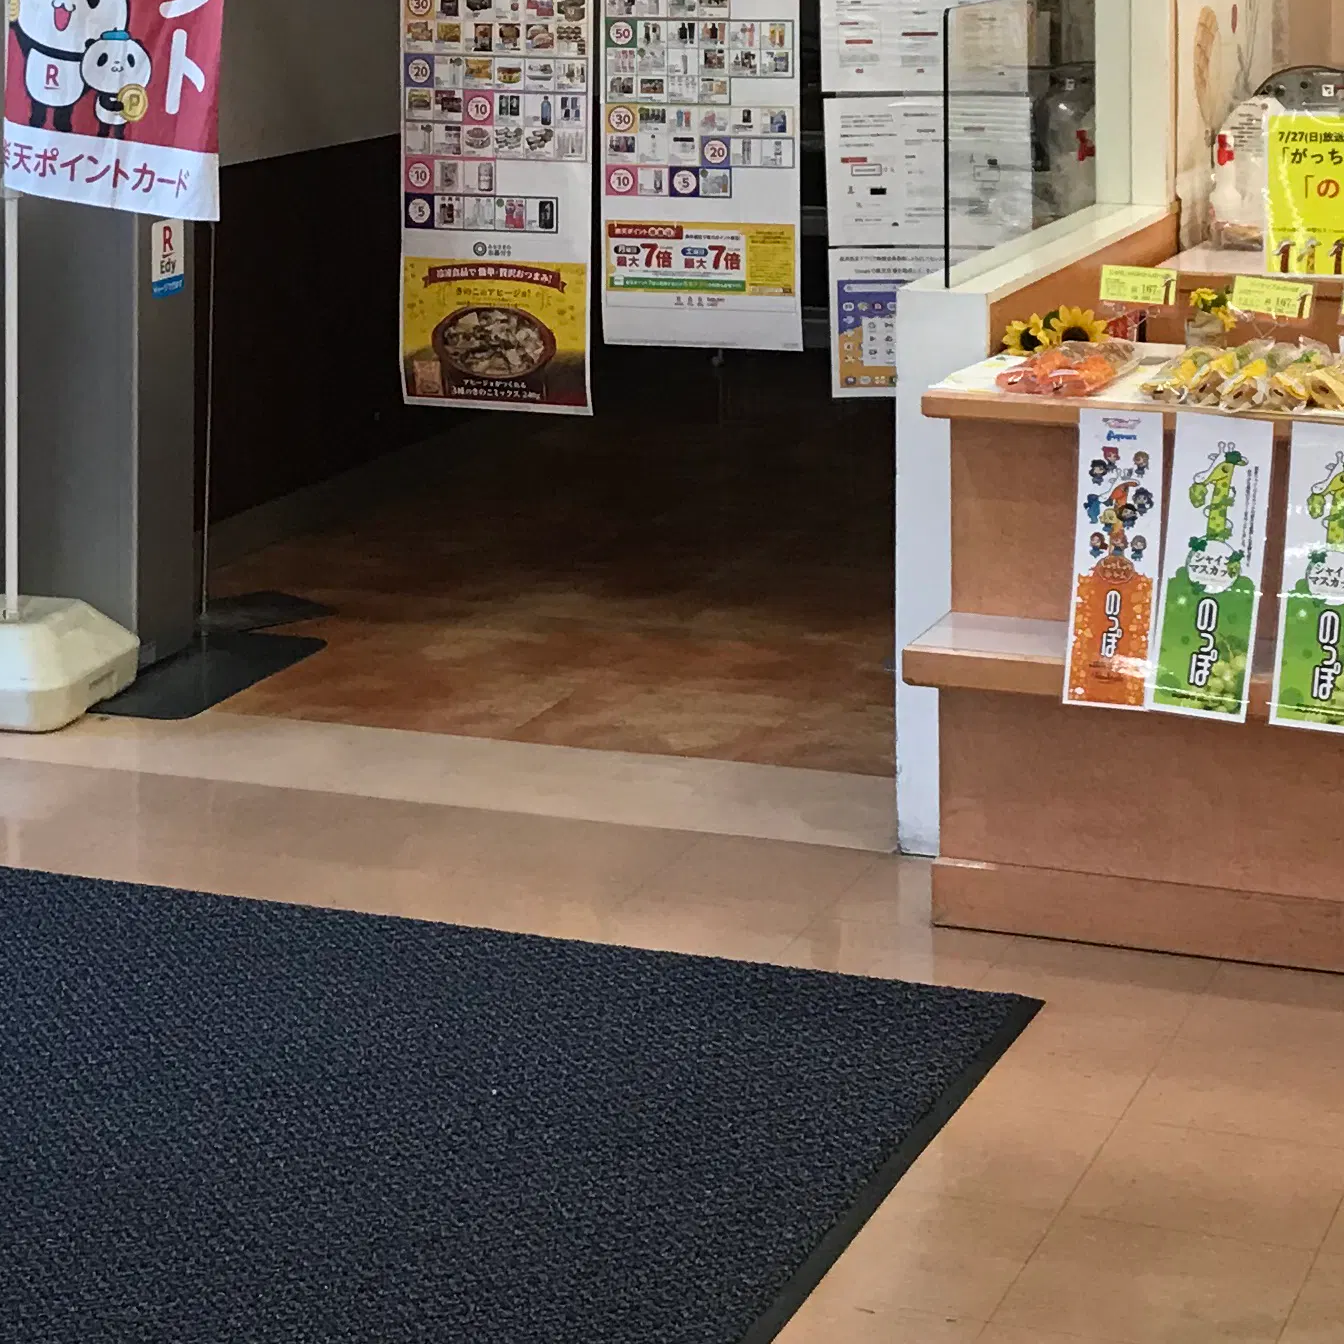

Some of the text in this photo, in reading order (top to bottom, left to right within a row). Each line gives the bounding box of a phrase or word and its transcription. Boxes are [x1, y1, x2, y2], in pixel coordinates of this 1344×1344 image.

[615, 28, 630, 39] 50
[414, 65, 428, 77] 20
[474, 104, 487, 116] 10
[615, 114, 630, 125] 30
[709, 147, 725, 158] 20
[415, 170, 427, 182] 10
[617, 176, 630, 187] 10
[682, 177, 690, 189] 5
[418, 205, 425, 218] 5
[160, 258, 177, 274] Edy
[1189, 564, 1236, 579] マスカッ
[1100, 589, 1123, 658] のっぽ
[1188, 597, 1219, 687] のっぽ
[1310, 609, 1343, 702] のっぽ
